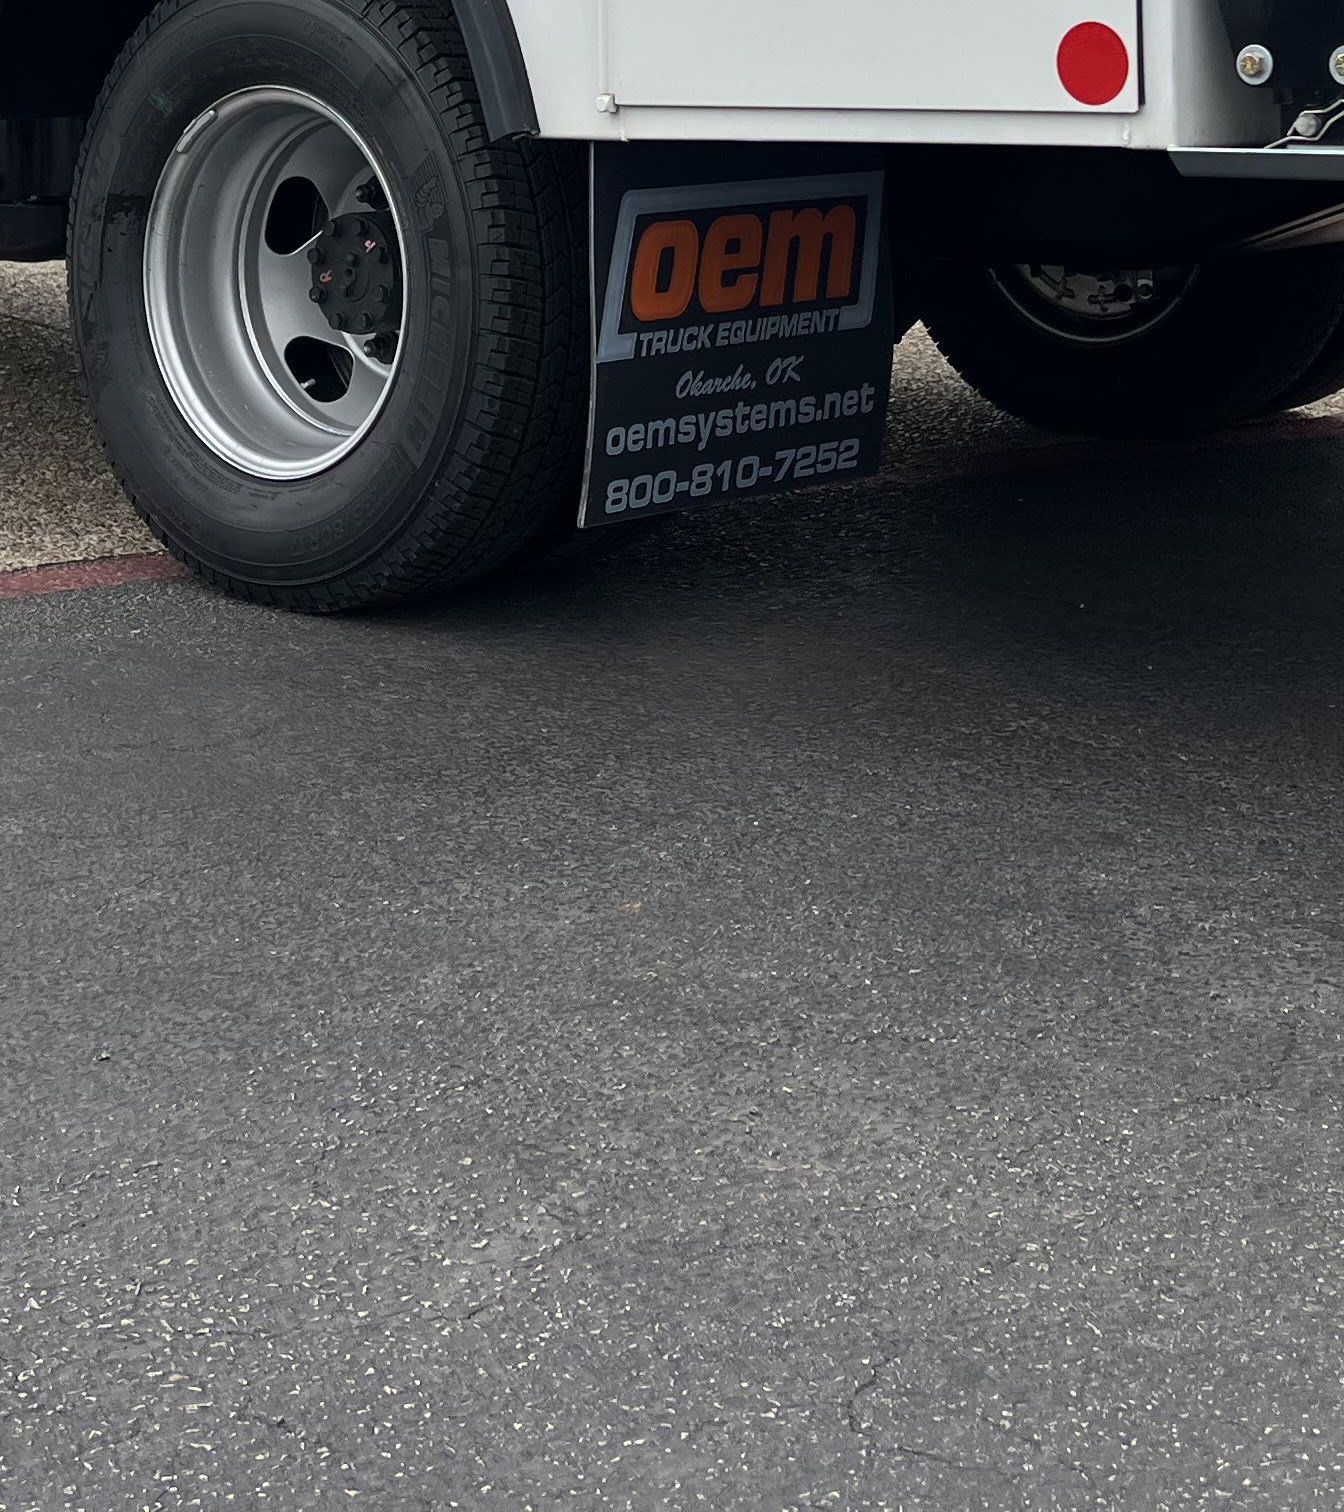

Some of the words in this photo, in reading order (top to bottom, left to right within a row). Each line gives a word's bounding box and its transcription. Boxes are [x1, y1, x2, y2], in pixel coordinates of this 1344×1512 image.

[630, 204, 856, 322] oem
[639, 327, 712, 358] TRUCK
[716, 308, 841, 347] EQUIPMENT
[675, 364, 757, 399] Okarche,
[765, 355, 805, 386] OK
[605, 382, 876, 456] oemsystems.net
[605, 438, 860, 514] 800-810-7252
